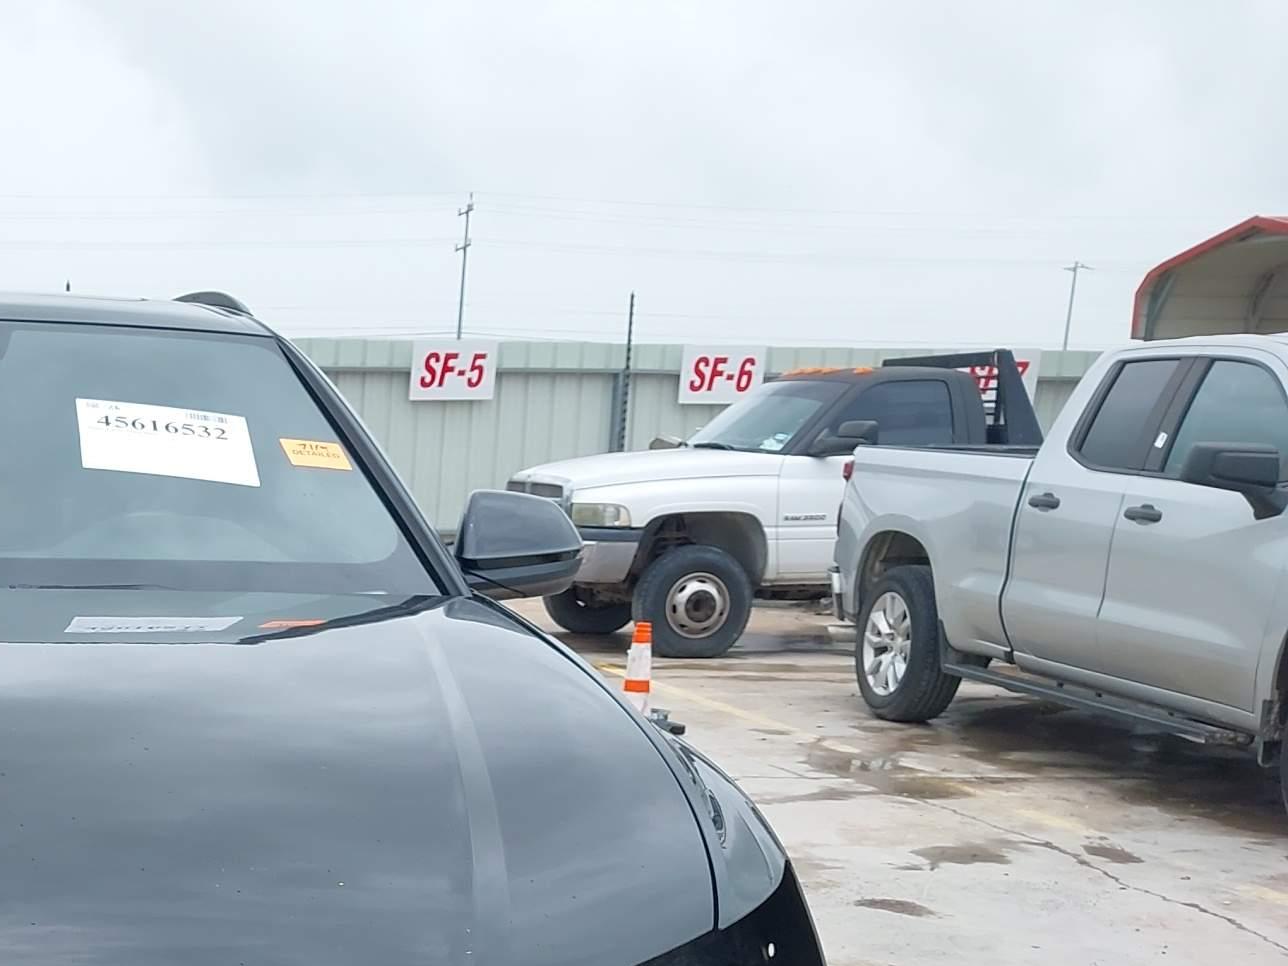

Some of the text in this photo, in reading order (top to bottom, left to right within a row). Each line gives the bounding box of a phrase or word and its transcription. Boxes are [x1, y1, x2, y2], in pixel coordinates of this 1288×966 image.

[419, 352, 487, 390] SF-5
[689, 356, 755, 392] SF-6
[96, 415, 228, 441] 45616532
